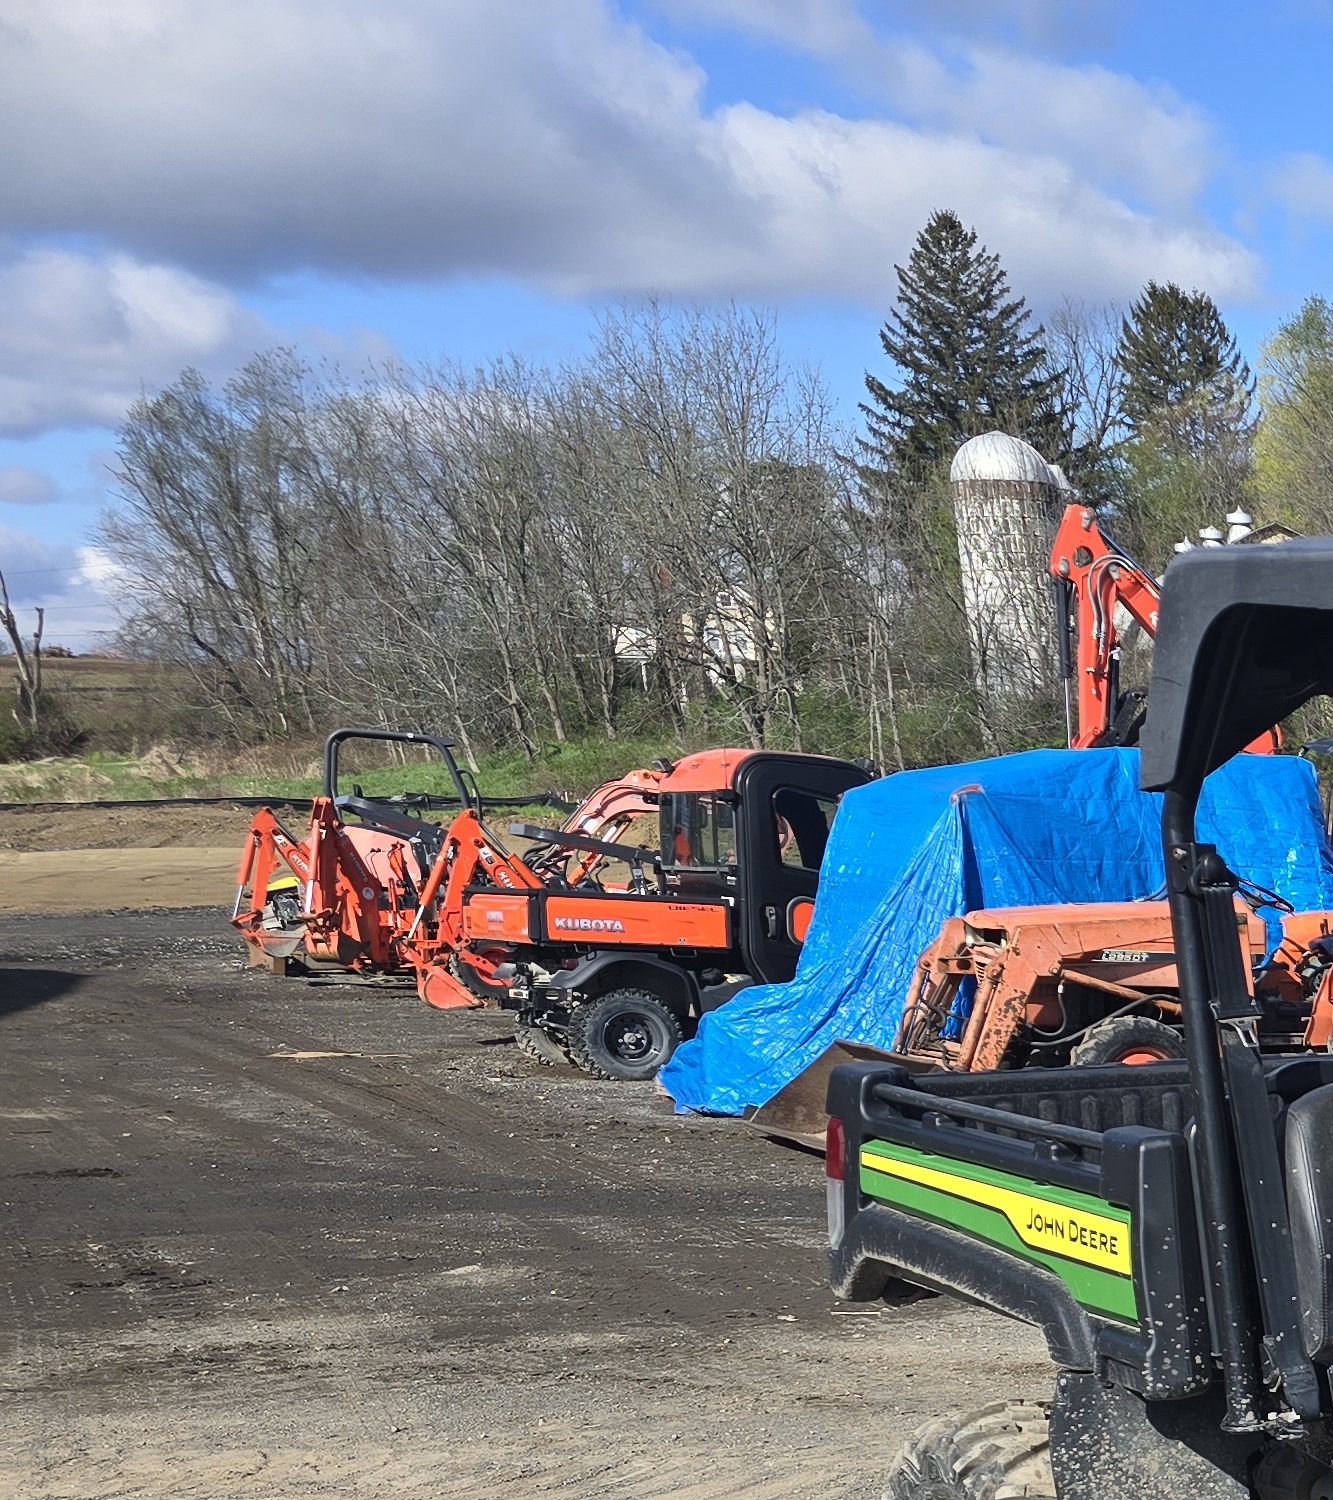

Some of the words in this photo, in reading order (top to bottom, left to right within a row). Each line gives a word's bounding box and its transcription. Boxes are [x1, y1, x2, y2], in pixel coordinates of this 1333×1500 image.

[554, 917, 625, 933] KUBOTA
[1026, 1208, 1064, 1239] JOHN
[1069, 1219, 1118, 1256] DEERE
